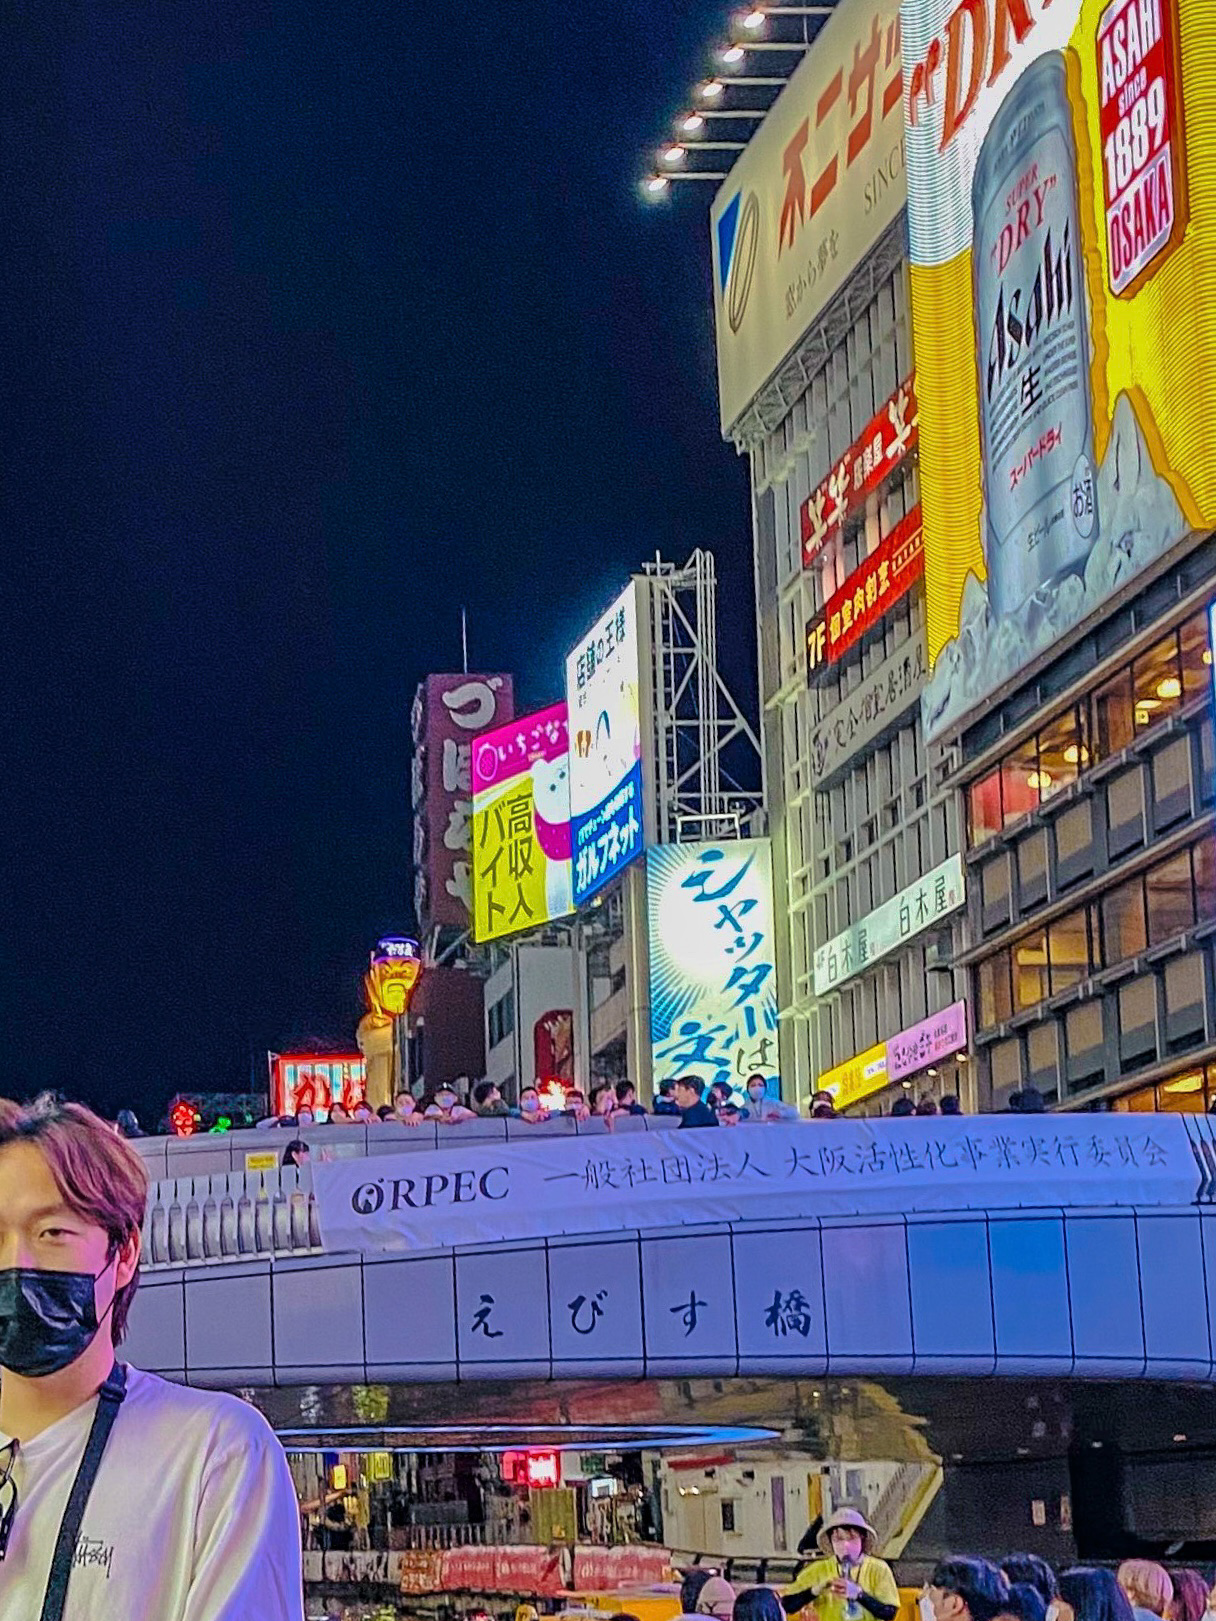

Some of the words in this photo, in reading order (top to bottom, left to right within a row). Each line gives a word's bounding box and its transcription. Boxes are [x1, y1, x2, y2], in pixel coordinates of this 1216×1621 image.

[1118, 66, 1147, 117] since
[1104, 76, 1166, 202] 1889
[1110, 155, 1170, 281] OSAKA
[986, 216, 1074, 405] Asahi
[1020, 366, 1044, 417] 生
[807, 620, 827, 670] 7F
[479, 799, 507, 932] バイト
[506, 792, 535, 925] 高収入
[899, 874, 948, 937] 白木屋
[828, 927, 869, 984] 白木屋
[543, 1151, 772, 1190] 一般社団法人
[784, 1135, 1168, 1178] 大阪活性化事業実行委員会
[471, 1289, 812, 1338] えびす橋
